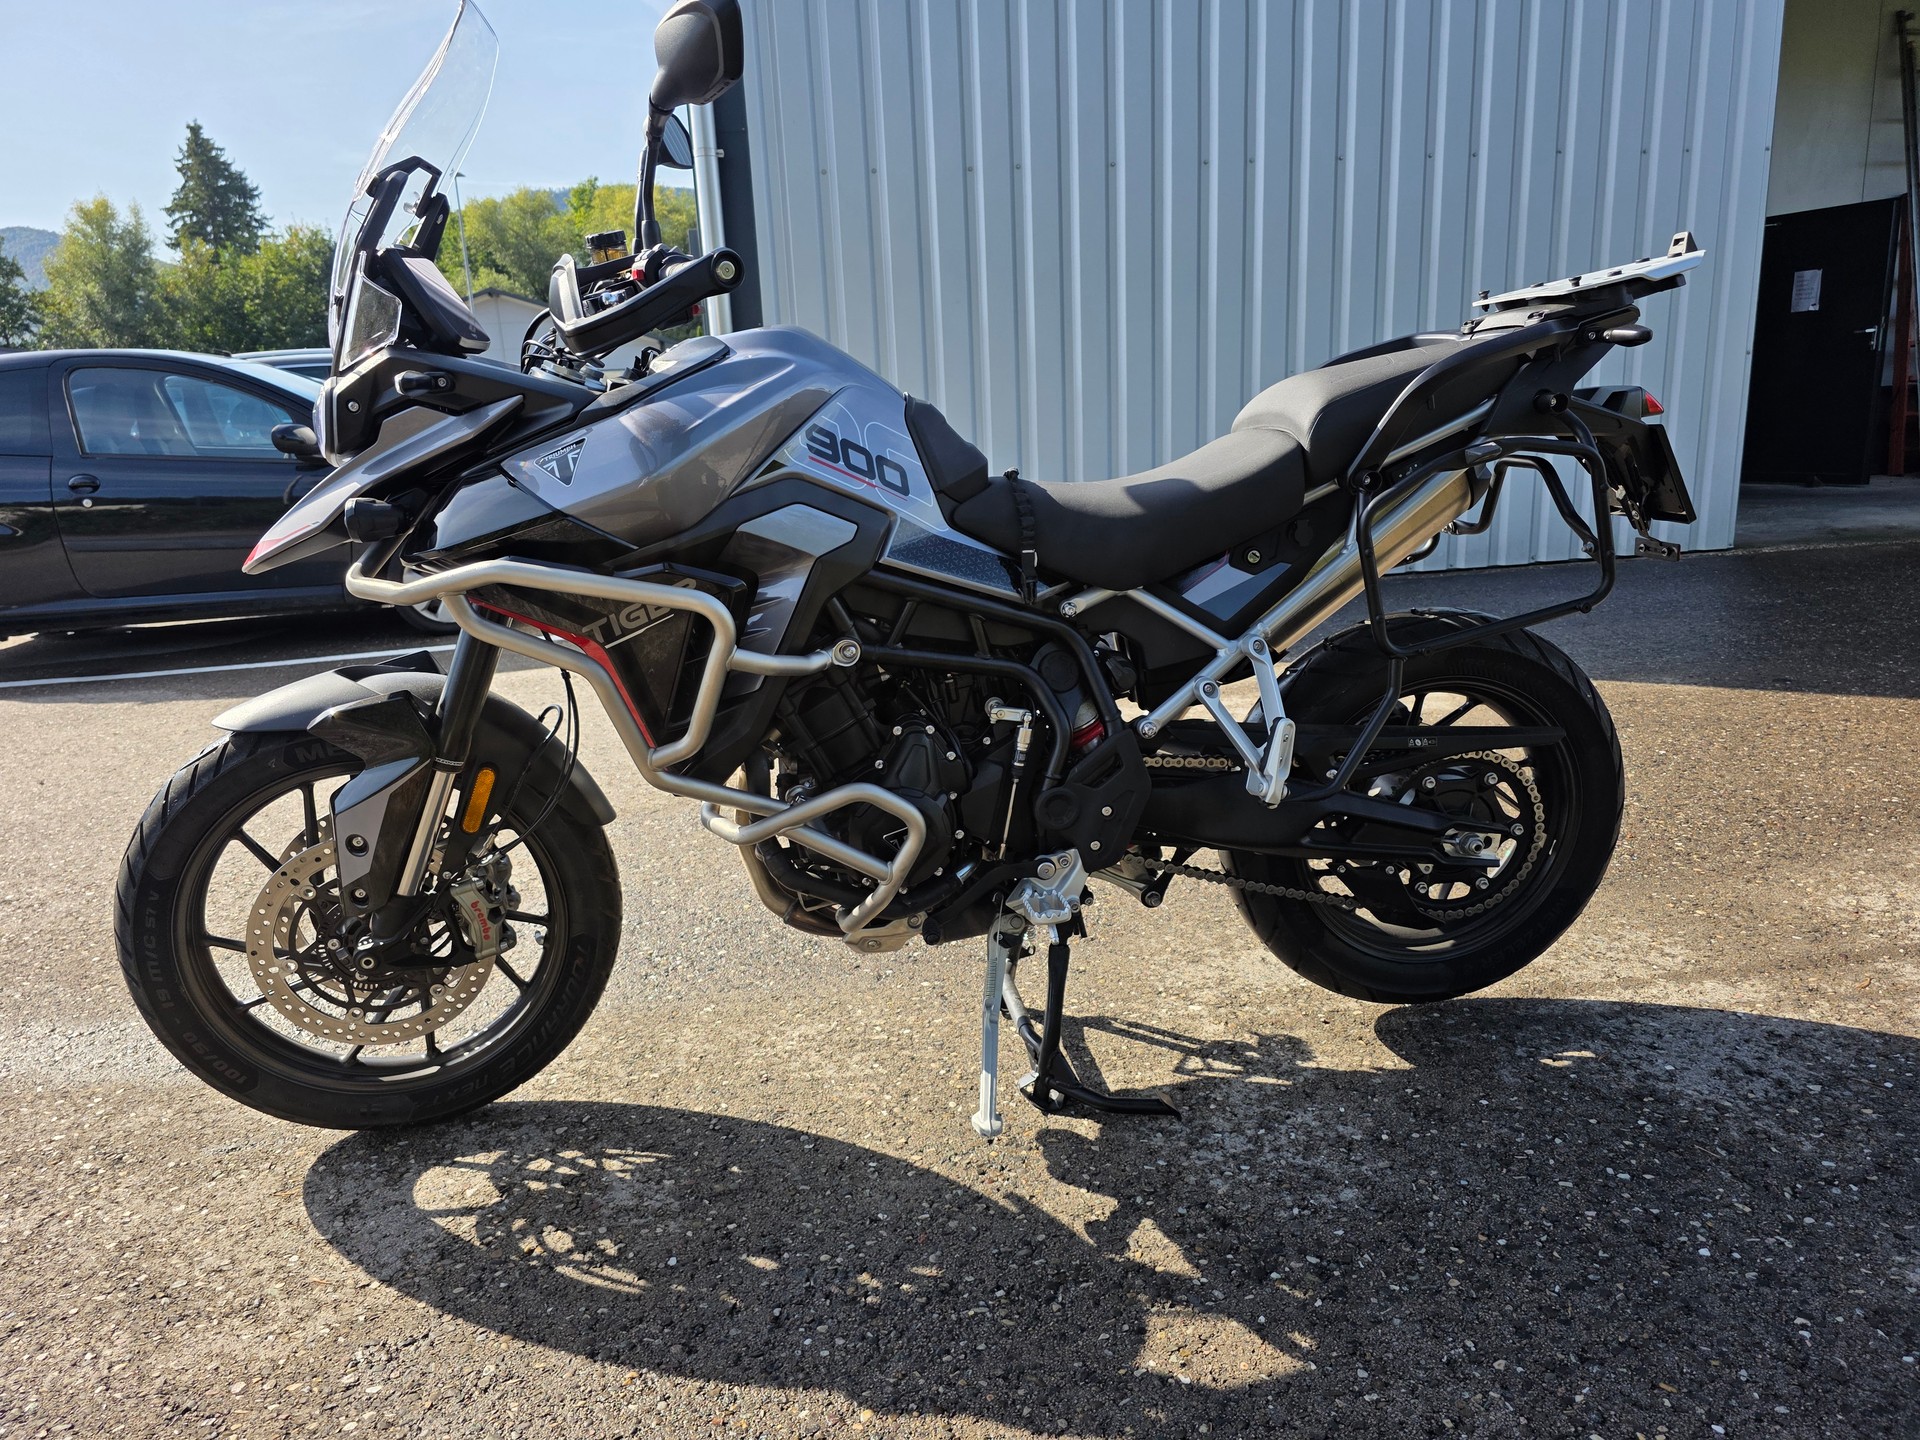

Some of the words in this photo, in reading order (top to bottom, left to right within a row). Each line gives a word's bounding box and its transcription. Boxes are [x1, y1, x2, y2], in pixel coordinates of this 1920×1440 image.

[544, 444, 577, 462] TRIUMPH
[805, 423, 910, 496] 900
[471, 900, 491, 941] brembo
[156, 989, 175, 1008] 19
[183, 1032, 248, 1084] 100/90
